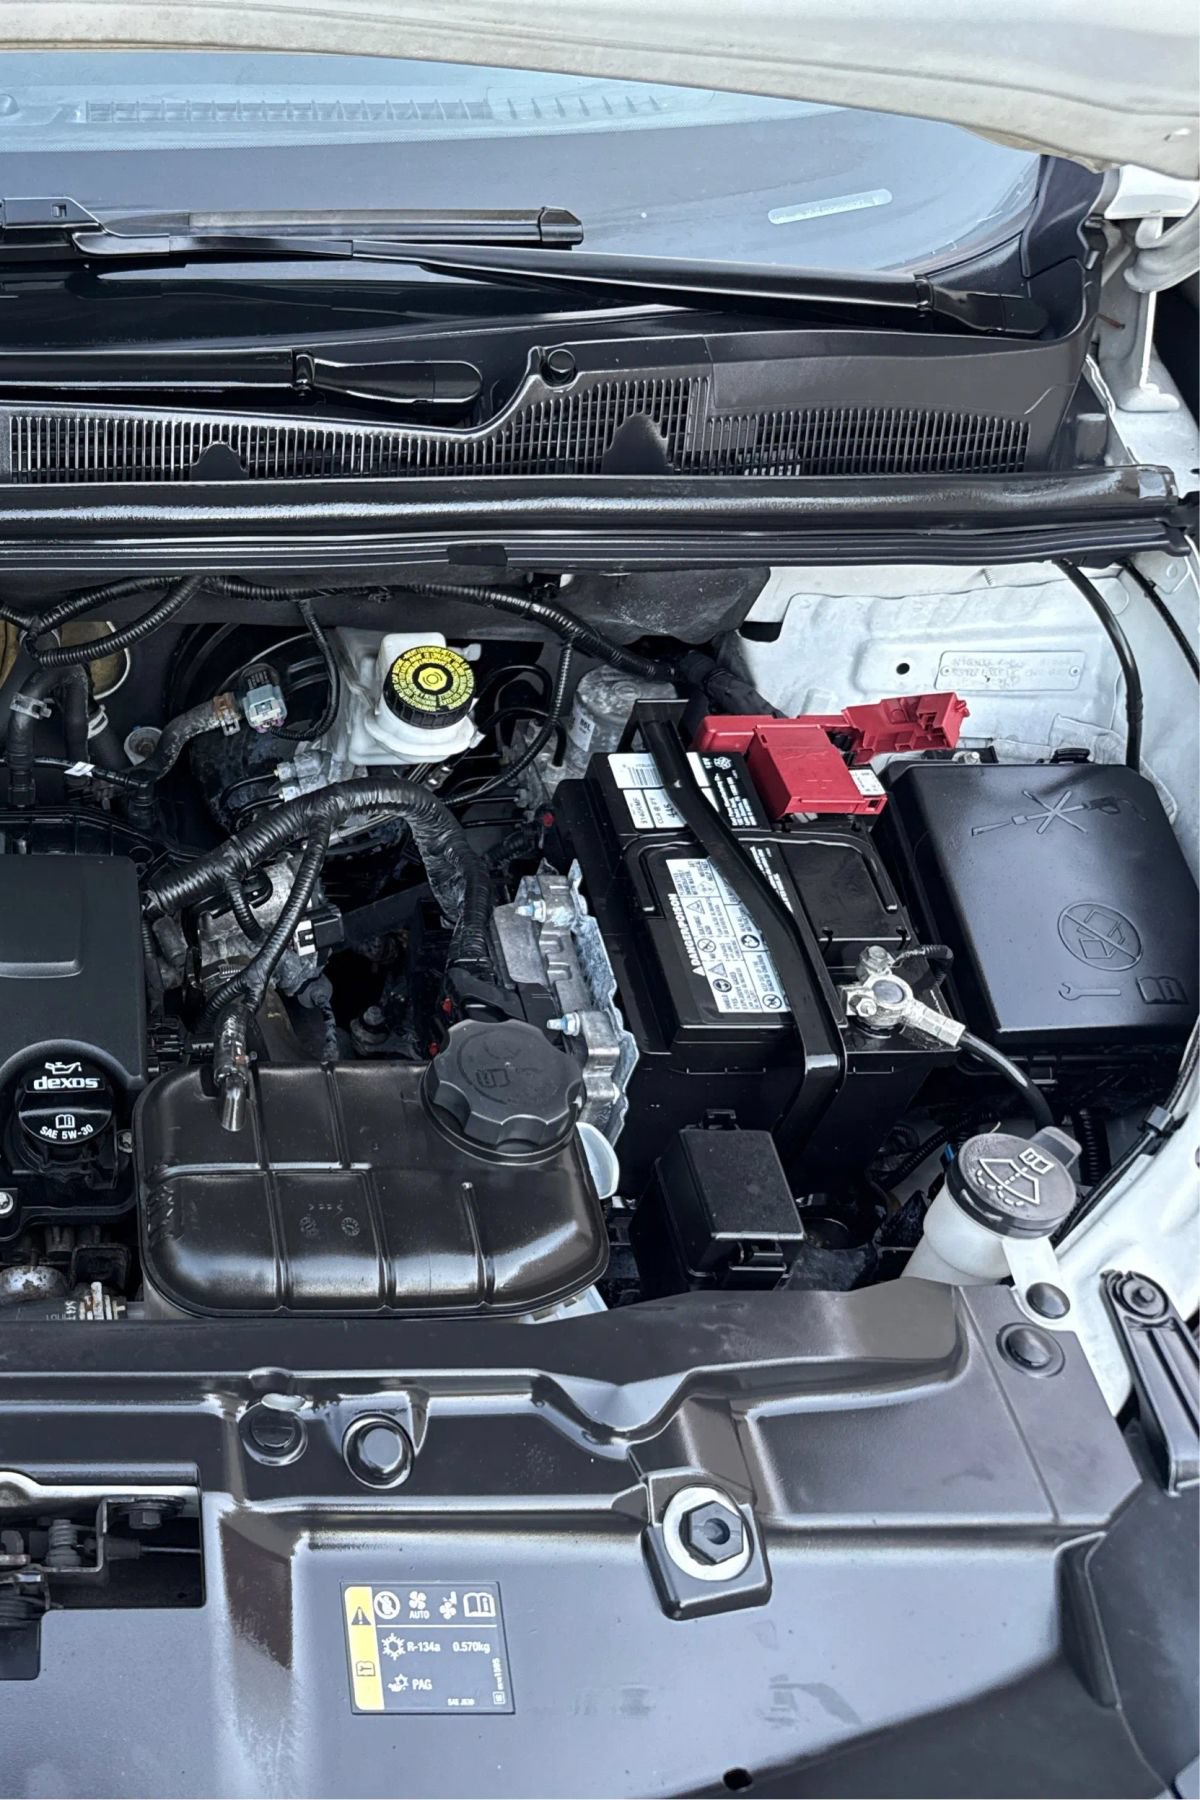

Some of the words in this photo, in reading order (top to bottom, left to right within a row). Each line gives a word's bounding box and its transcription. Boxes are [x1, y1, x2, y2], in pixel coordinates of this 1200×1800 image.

[668, 893, 702, 966] DANGER/POISON
[33, 1076, 100, 1090] dexos
[40, 1126, 58, 1140] SAE
[61, 1124, 94, 1140] 5W-30
[409, 1610, 430, 1620] AUTO
[406, 1641, 441, 1653] R-134a
[452, 1641, 491, 1654] 0.570kg
[412, 1678, 433, 1690] PAG
